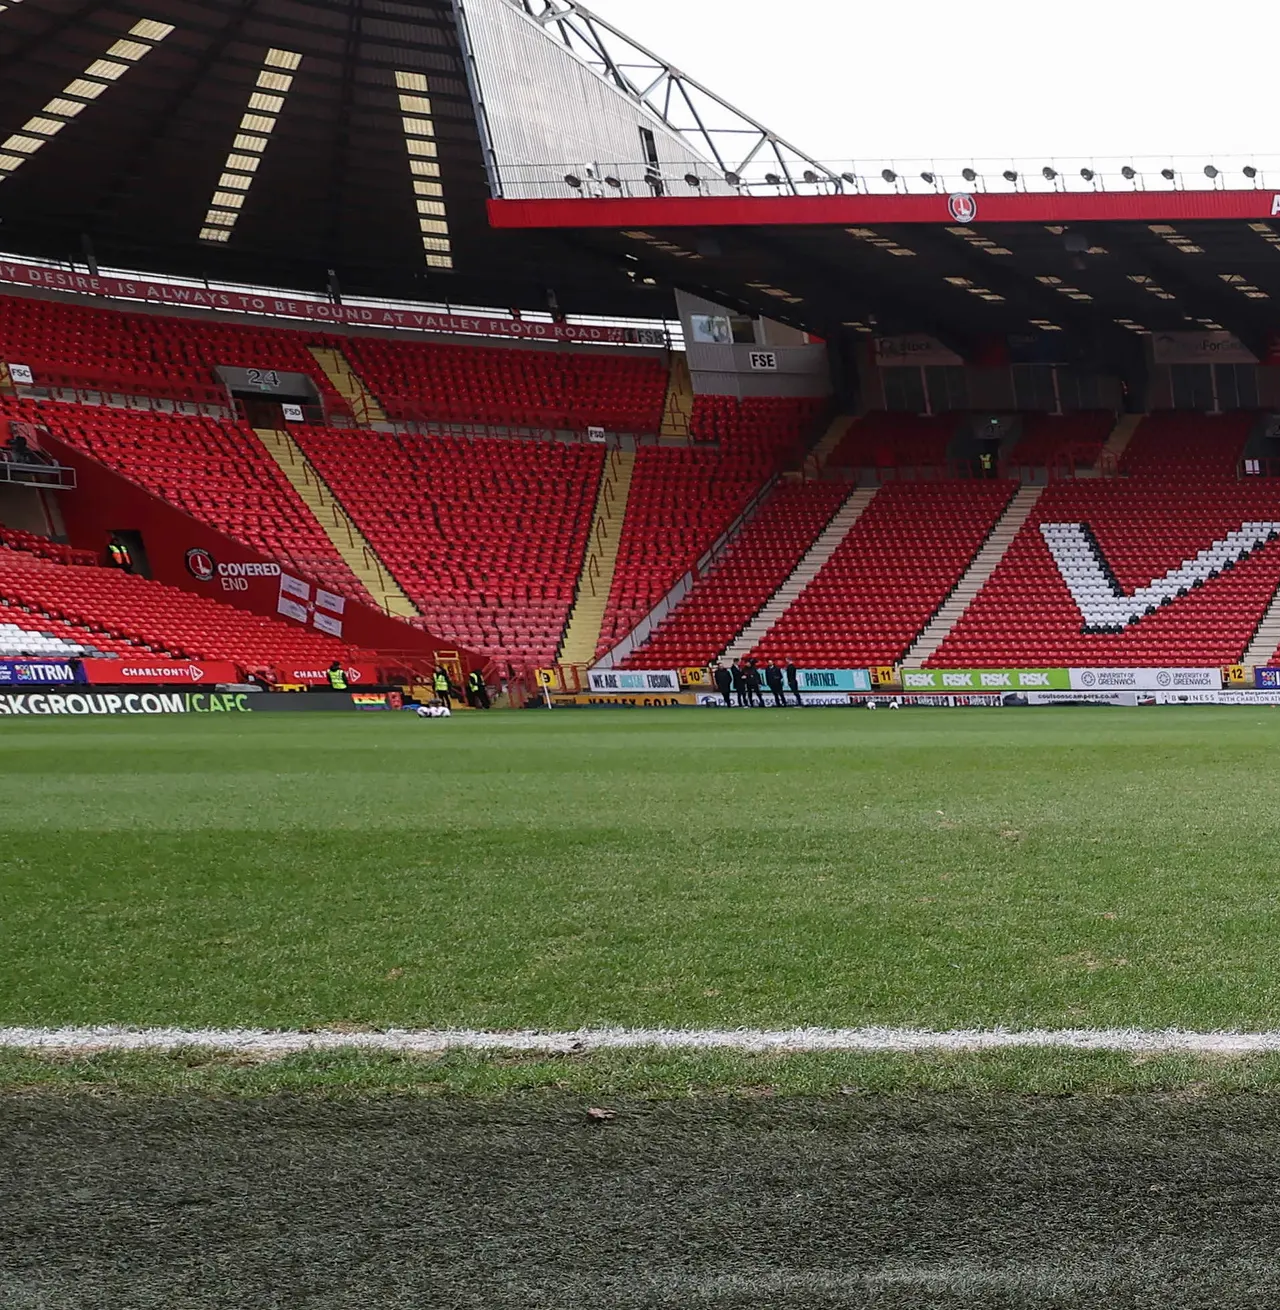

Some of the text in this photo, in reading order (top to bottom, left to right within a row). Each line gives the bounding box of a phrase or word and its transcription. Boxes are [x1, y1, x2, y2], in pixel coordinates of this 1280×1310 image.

[29, 269, 108, 292] DESIRE,
[118, 282, 136, 295] IS
[147, 285, 230, 306] ALWAYS
[239, 297, 265, 309] TO
[275, 301, 297, 314] BE
[306, 304, 373, 322] FOUND
[383, 312, 405, 325] AT
[413, 314, 481, 331] VALLEY
[490, 321, 546, 336] FLOYD
[554, 326, 601, 340] ROAD
[751, 354, 775, 367] FSE
[11, 367, 30, 378] FSC
[247, 369, 281, 386] 24
[284, 408, 301, 417] FSD
[217, 562, 281, 577] COVERED
[221, 577, 248, 591] END
[30, 665, 75, 681] ITRM
[689, 671, 700, 682] 10
[881, 671, 891, 681] 11
[905, 673, 1049, 687] RSK RSK RSK RSK
[1231, 669, 1243, 679] 12
[592, 674, 605, 689] WE
[605, 674, 619, 689] ARE
